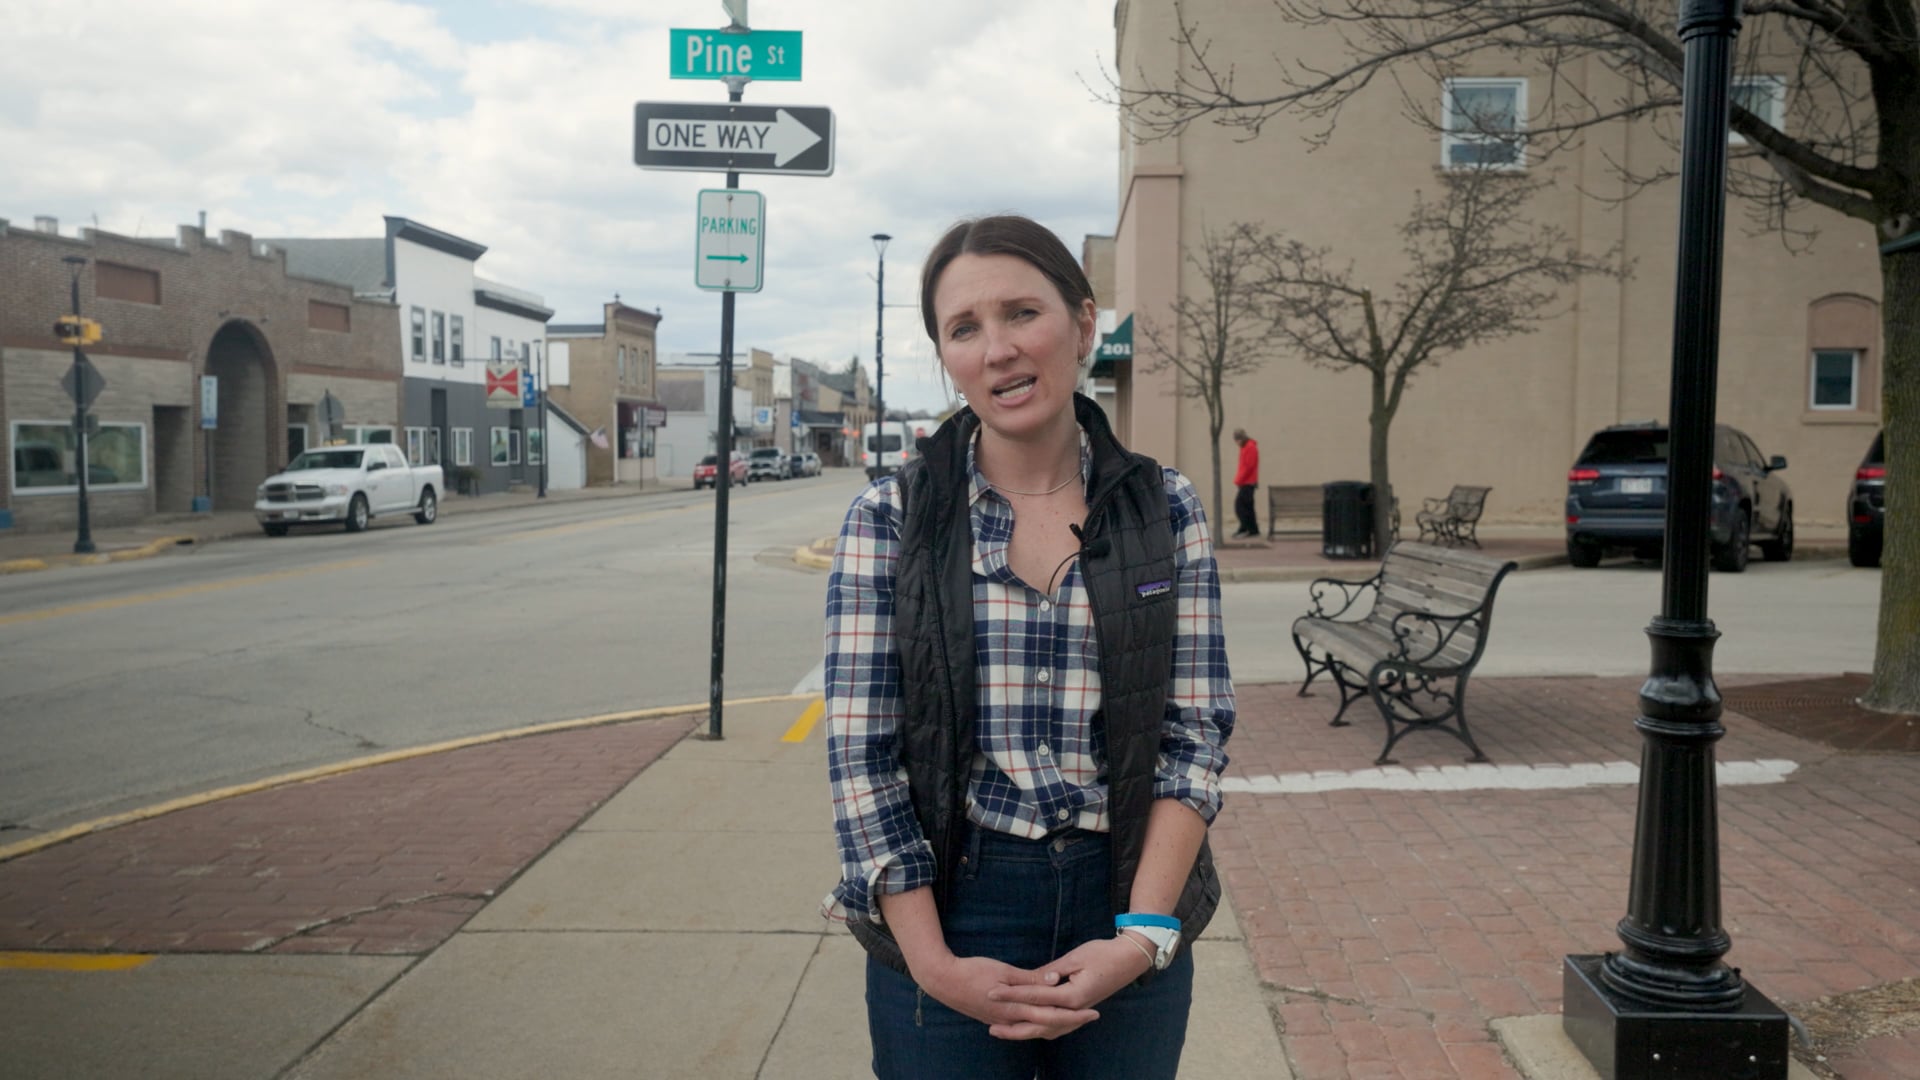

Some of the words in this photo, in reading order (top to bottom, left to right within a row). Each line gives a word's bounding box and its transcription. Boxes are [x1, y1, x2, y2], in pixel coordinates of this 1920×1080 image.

[686, 35, 753, 73] Pine
[767, 45, 785, 65] St
[655, 122, 707, 148] ONE
[717, 124, 770, 150] WAY
[701, 216, 757, 236] PARKING
[1102, 343, 1131, 355] 201
